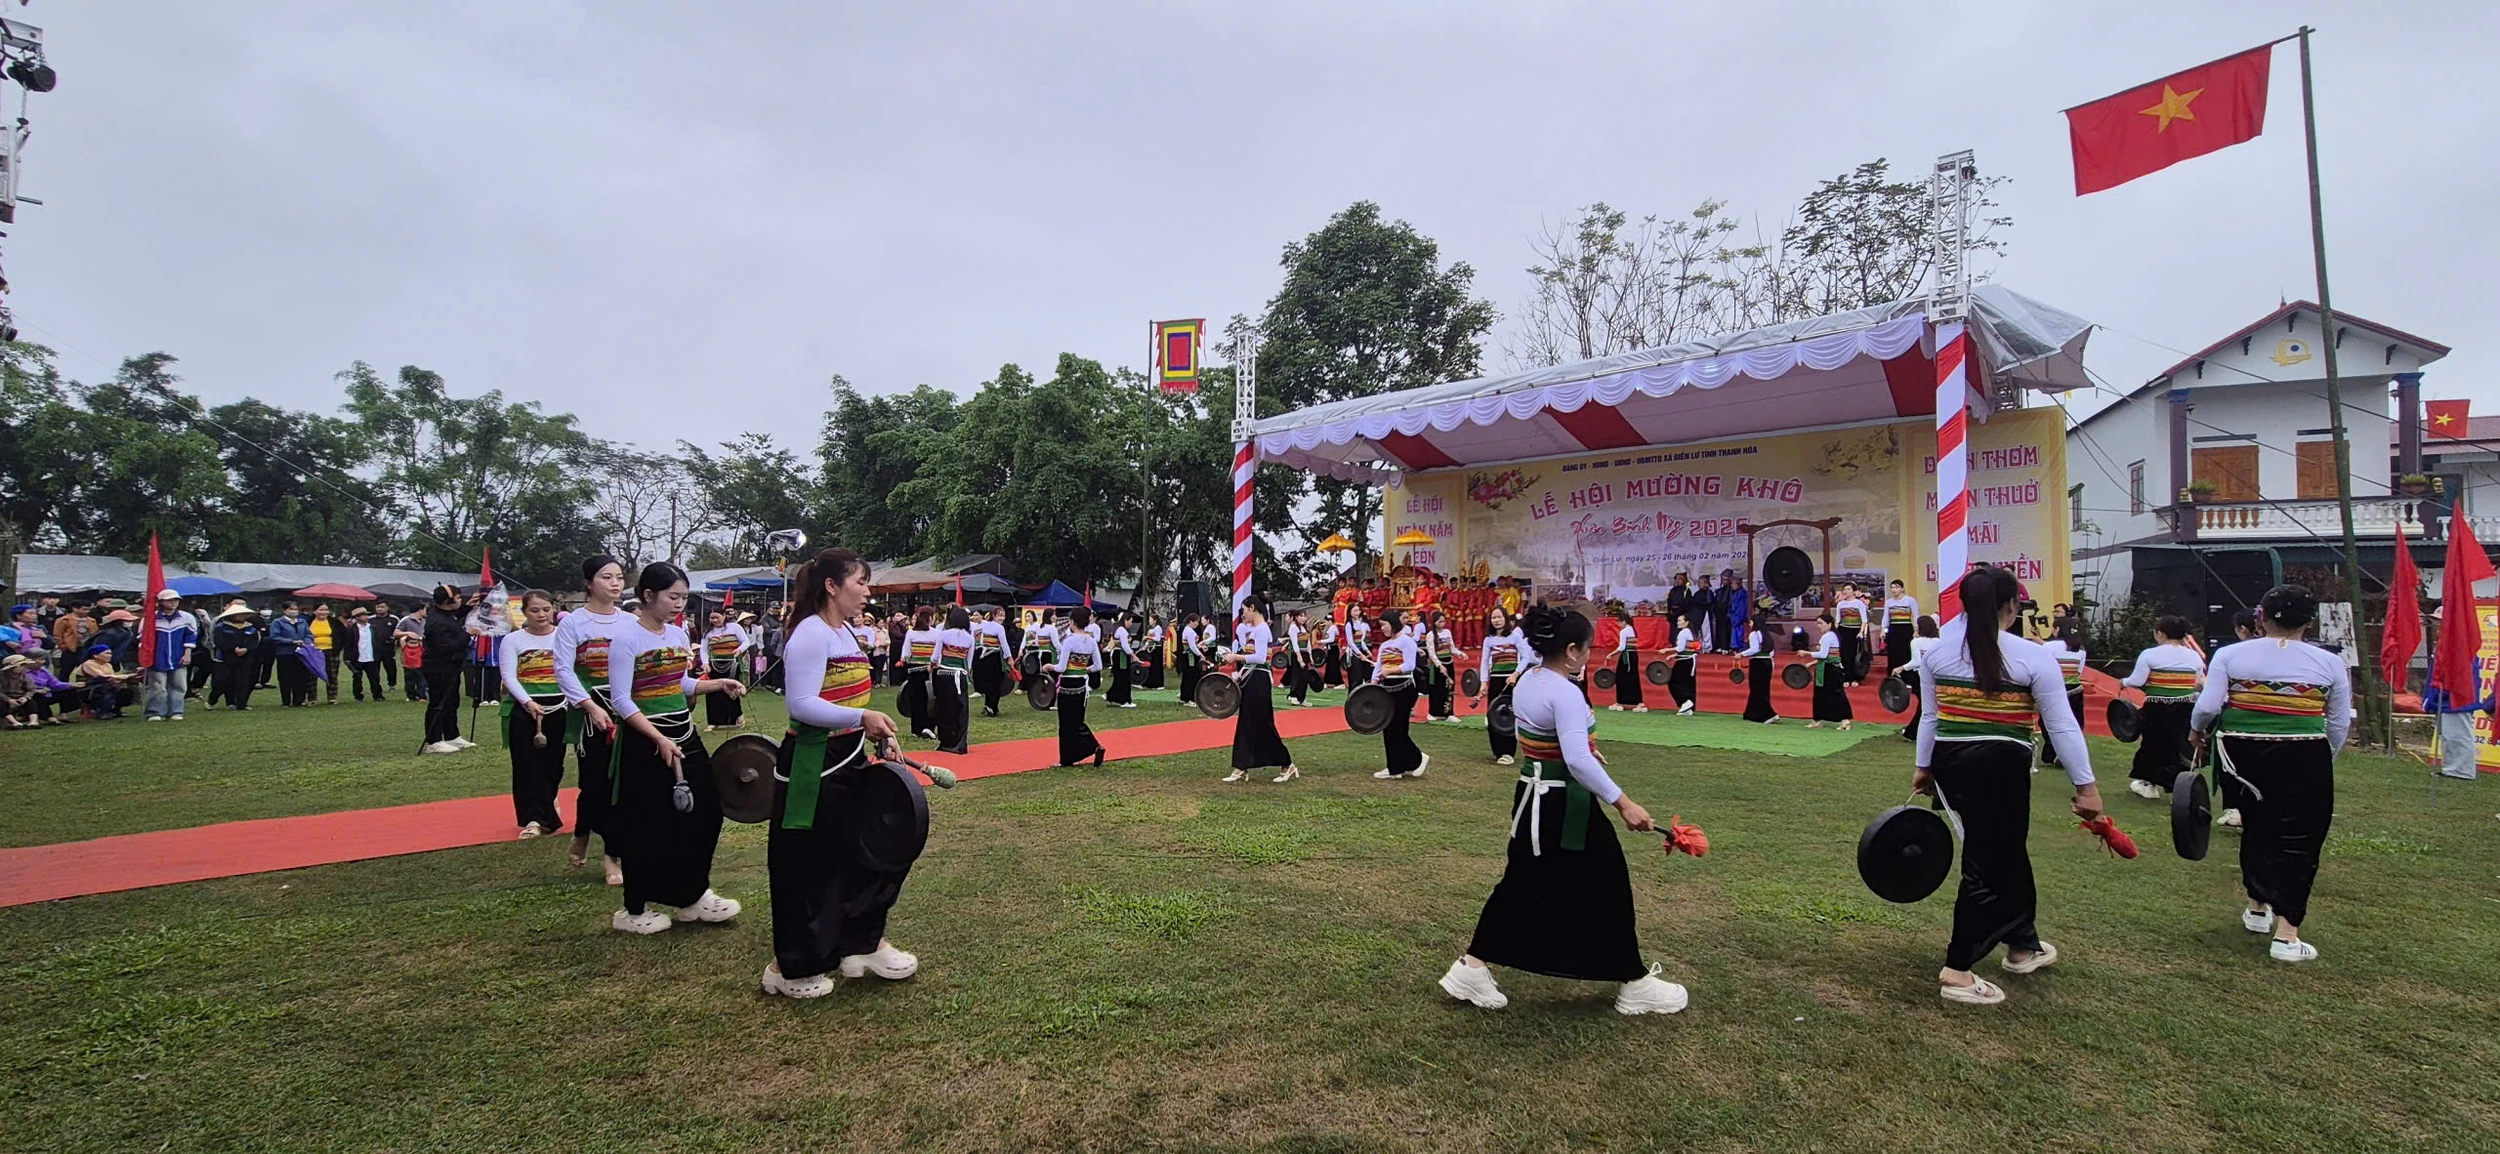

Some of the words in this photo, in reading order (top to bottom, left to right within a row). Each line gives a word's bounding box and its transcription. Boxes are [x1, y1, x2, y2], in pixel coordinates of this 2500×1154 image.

[1718, 447, 1741, 457] THANH
[1982, 444, 2039, 469] THƠM
[1530, 490, 1559, 520] LỄ
[1569, 482, 1613, 509] HỘI
[1626, 473, 1722, 499] MƯỜNG
[1735, 477, 1804, 503] KHÔ
[1984, 478, 2039, 506] THUỞ
[1406, 494, 1420, 513] LỄ
[1423, 494, 1443, 515] HỘI
[1429, 521, 1453, 537] NĂM
[1967, 521, 1999, 544] MÃI
[1625, 554, 1645, 564] ngày
[1662, 553, 1672, 561] 26
[1674, 552, 1697, 562] tháng
[1699, 552, 1710, 560] 02
[1710, 552, 1730, 560] năm
